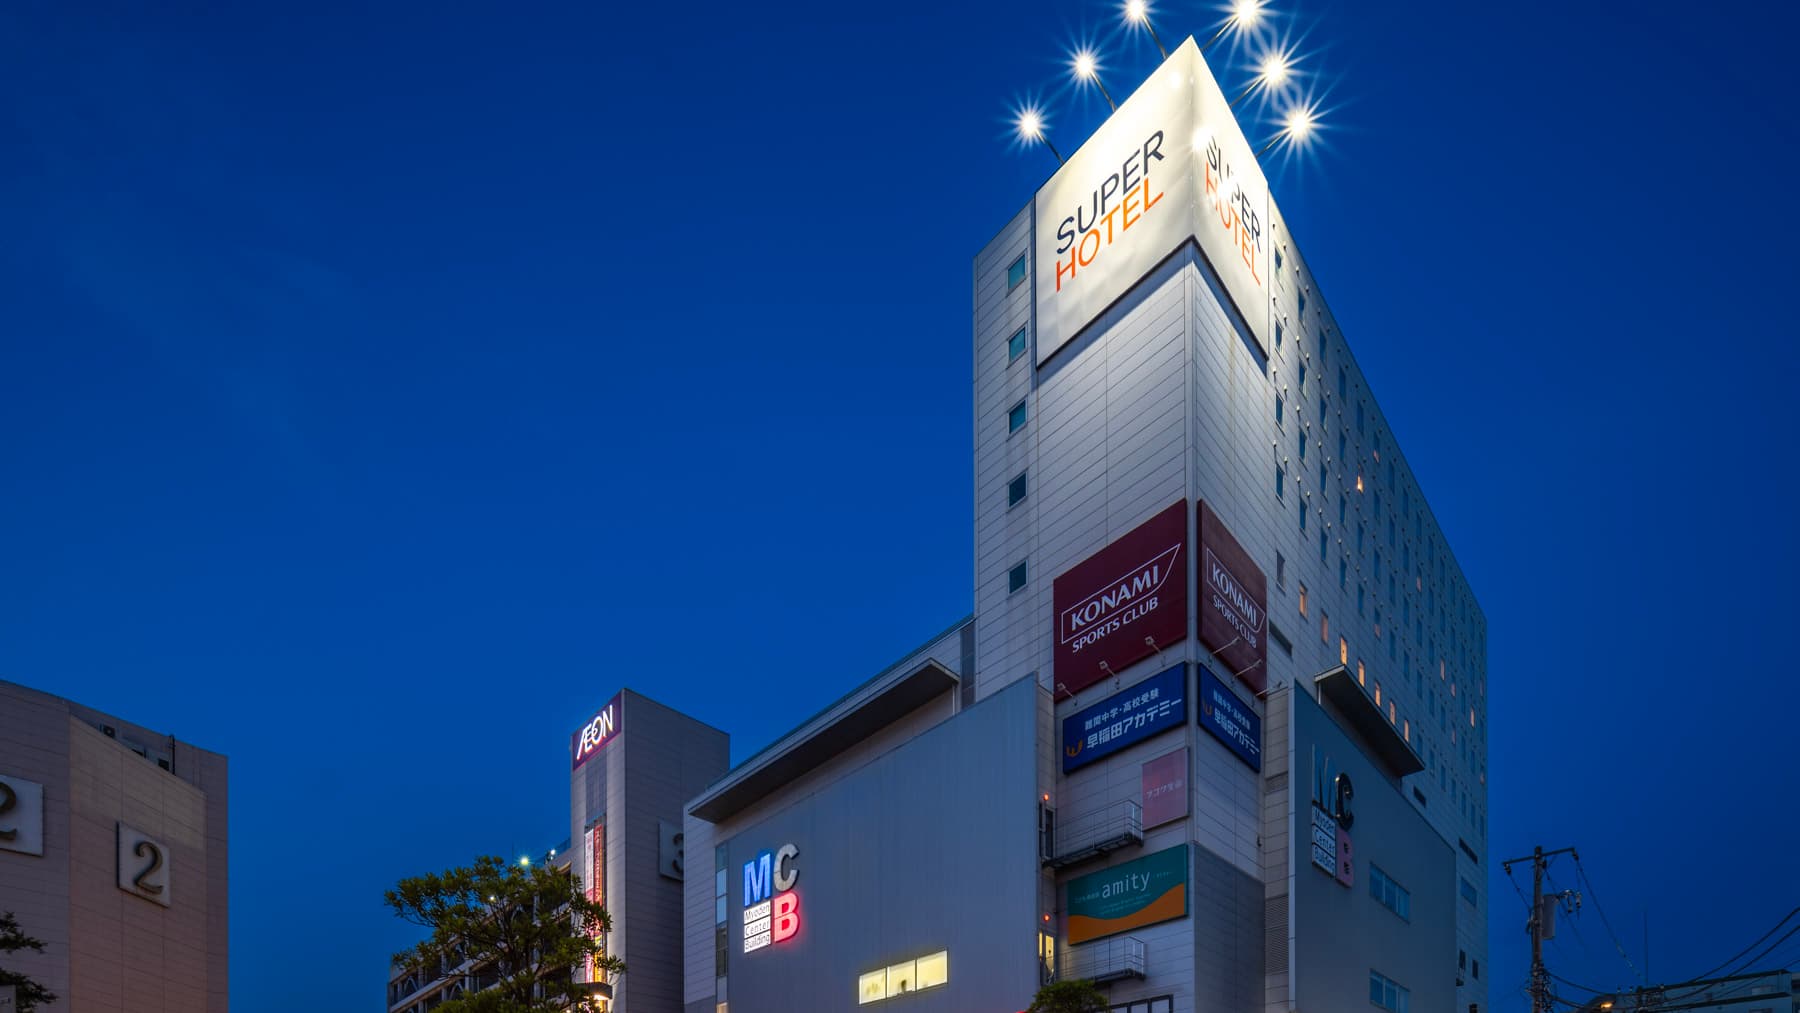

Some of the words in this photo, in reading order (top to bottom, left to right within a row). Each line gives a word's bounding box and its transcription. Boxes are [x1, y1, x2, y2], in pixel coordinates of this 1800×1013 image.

[1056, 130, 1165, 254] SUPER
[1056, 176, 1164, 293] HOTEL
[1071, 564, 1159, 631] KONAMI
[1212, 562, 1257, 626] KONAMI
[1213, 594, 1239, 631] SPORTS
[1239, 623, 1257, 649] CLUB
[1072, 617, 1120, 653] SPORTS
[1122, 596, 1159, 625] CLUB
[1087, 698, 1182, 749] 早稲田アカデミー
[133, 841, 164, 895] 2
[743, 843, 800, 907] MC
[1336, 825, 1354, 888] B
[1102, 872, 1150, 899] amity
[745, 920, 771, 937] Center
[745, 933, 771, 951] Building
[774, 892, 800, 943] B
